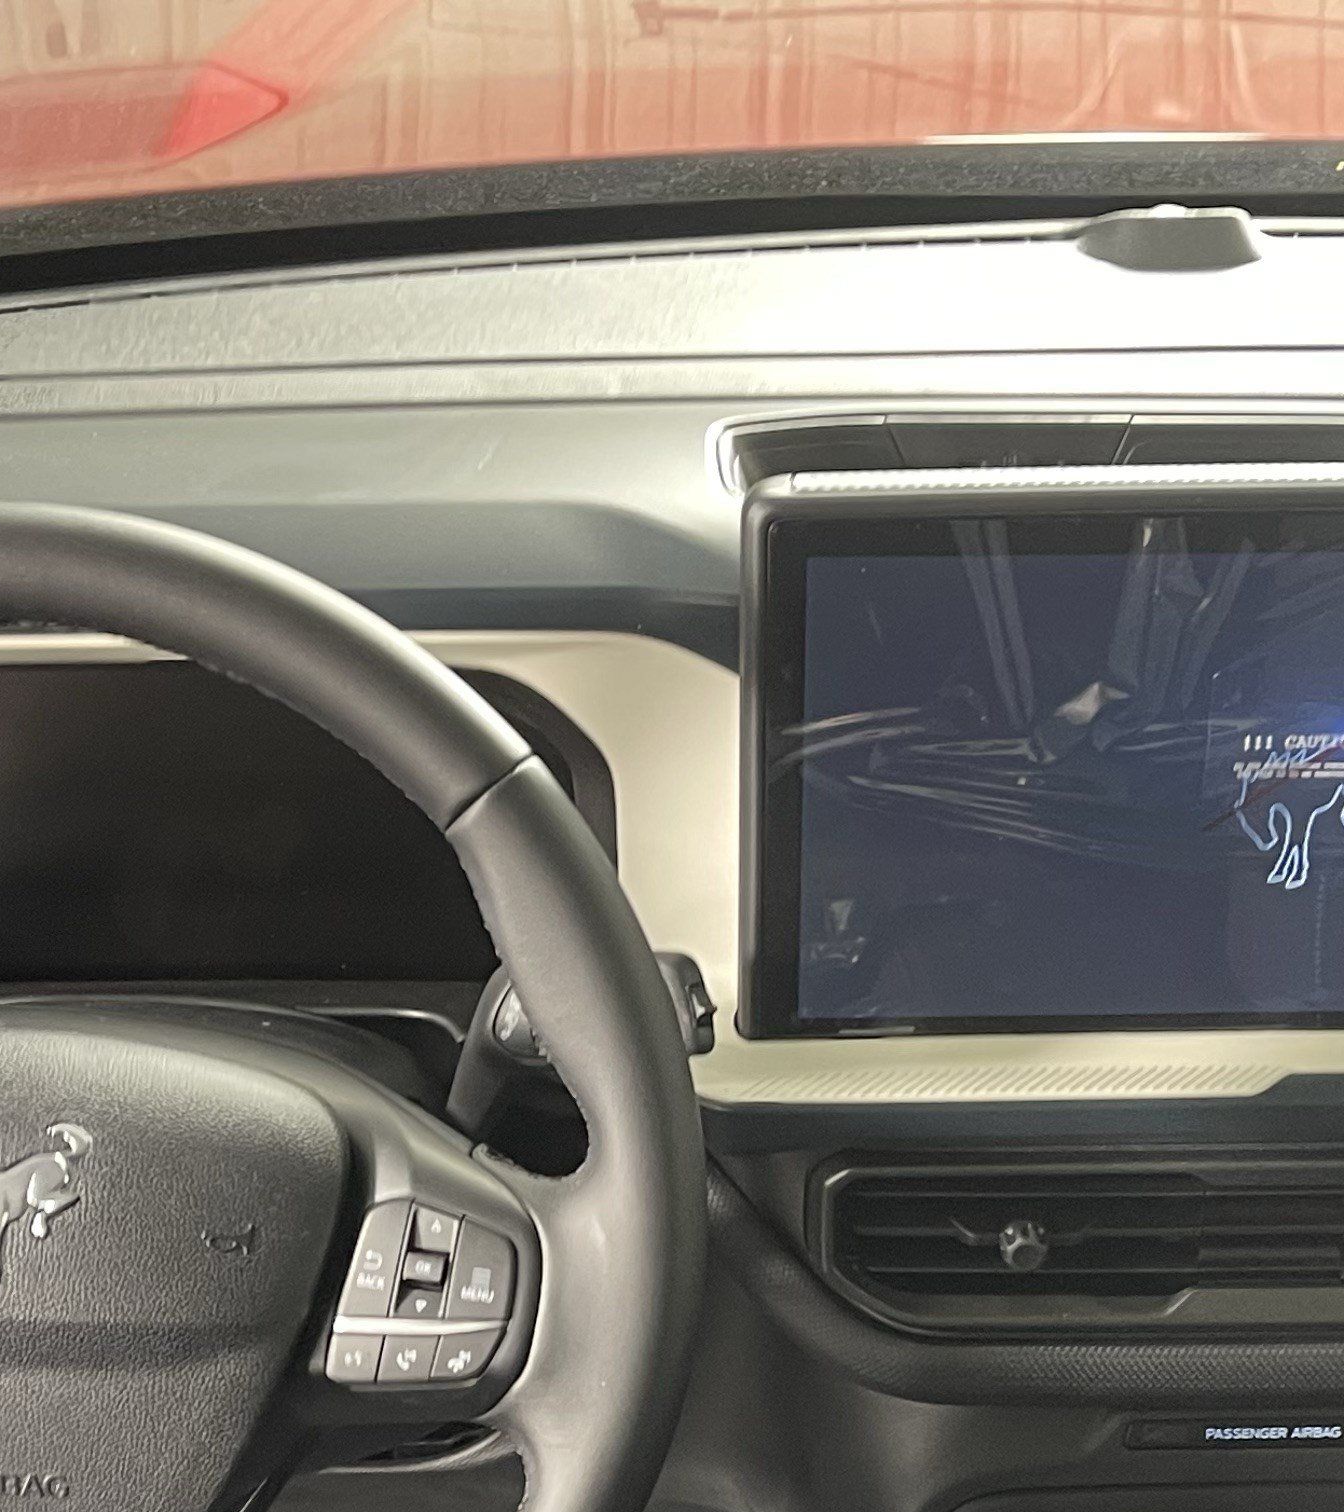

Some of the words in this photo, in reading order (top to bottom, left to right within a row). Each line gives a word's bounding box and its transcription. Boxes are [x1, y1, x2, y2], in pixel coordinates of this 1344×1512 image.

[414, 1261, 431, 1275] OK
[356, 1272, 386, 1291] BACK
[1205, 1427, 1287, 1440] PASSENGER
[1290, 1426, 1342, 1439] AIRBAG
